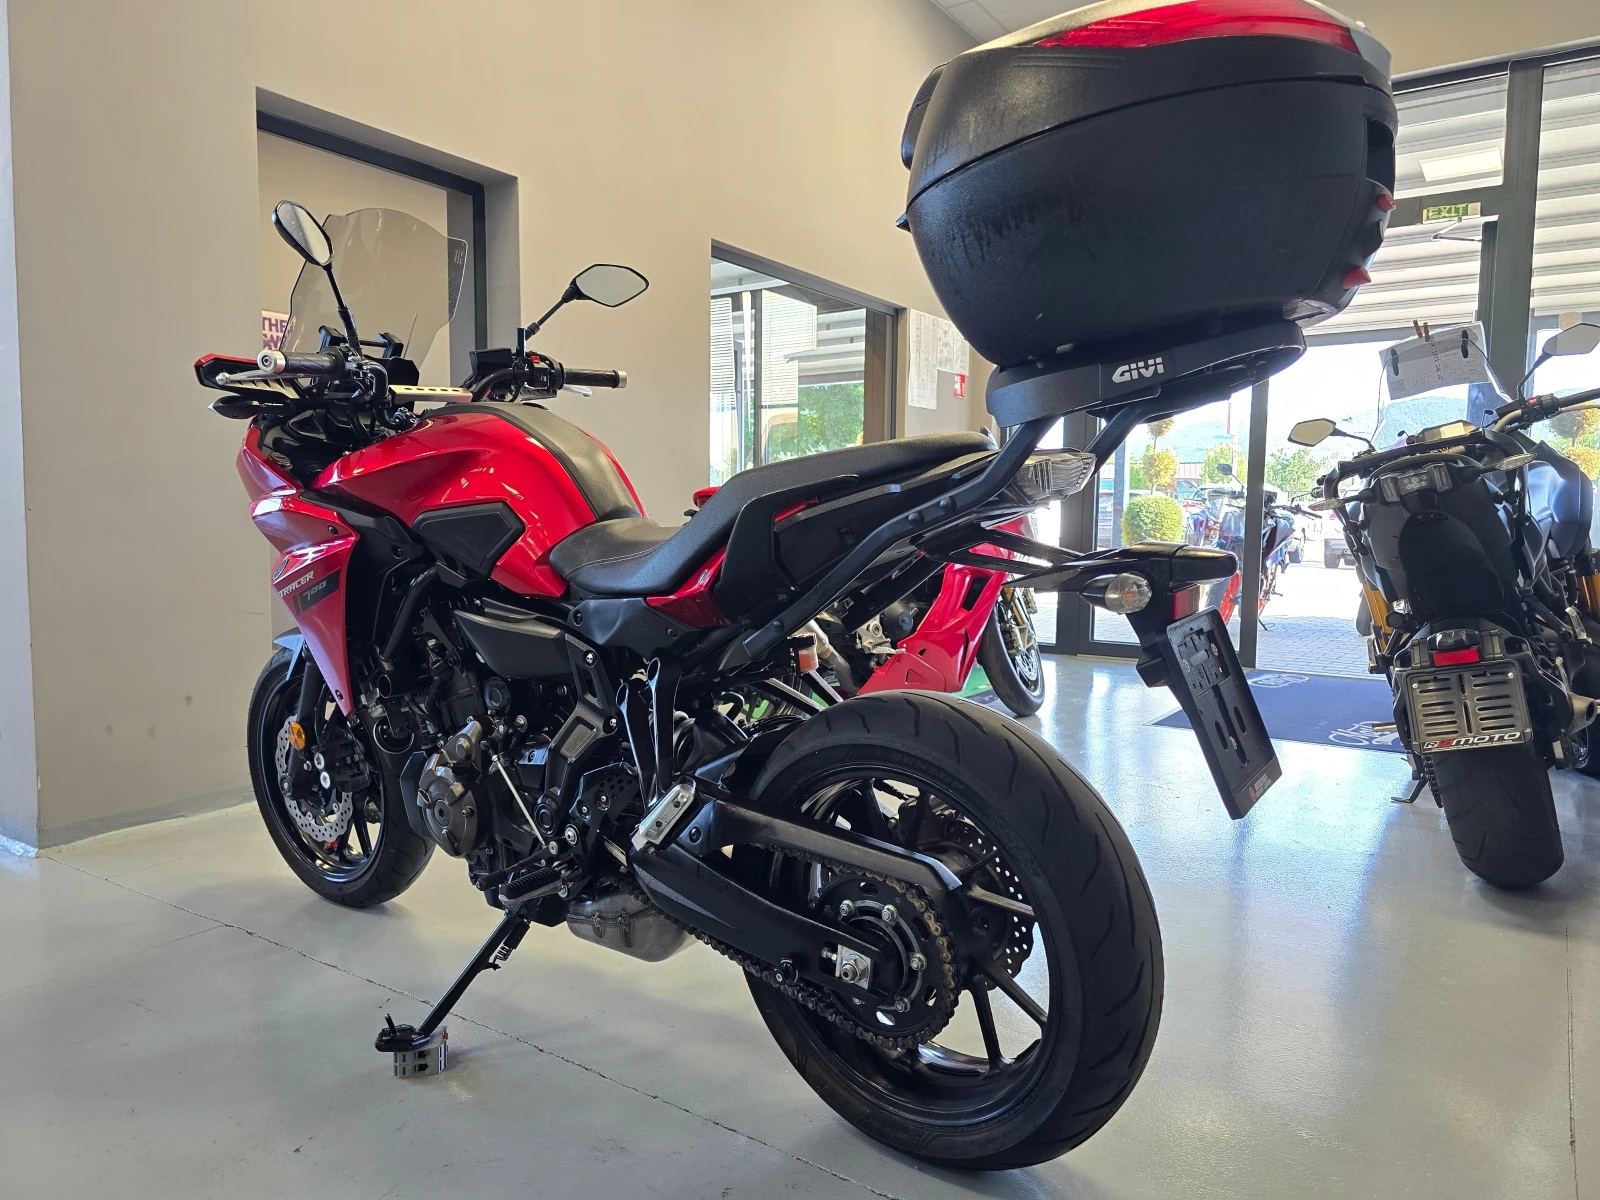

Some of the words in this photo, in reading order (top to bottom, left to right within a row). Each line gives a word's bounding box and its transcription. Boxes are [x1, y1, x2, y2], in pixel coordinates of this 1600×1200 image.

[1428, 205, 1465, 219] EXIT
[1111, 356, 1164, 383] GIVI
[279, 570, 314, 598] TRACER
[303, 580, 327, 601] 700
